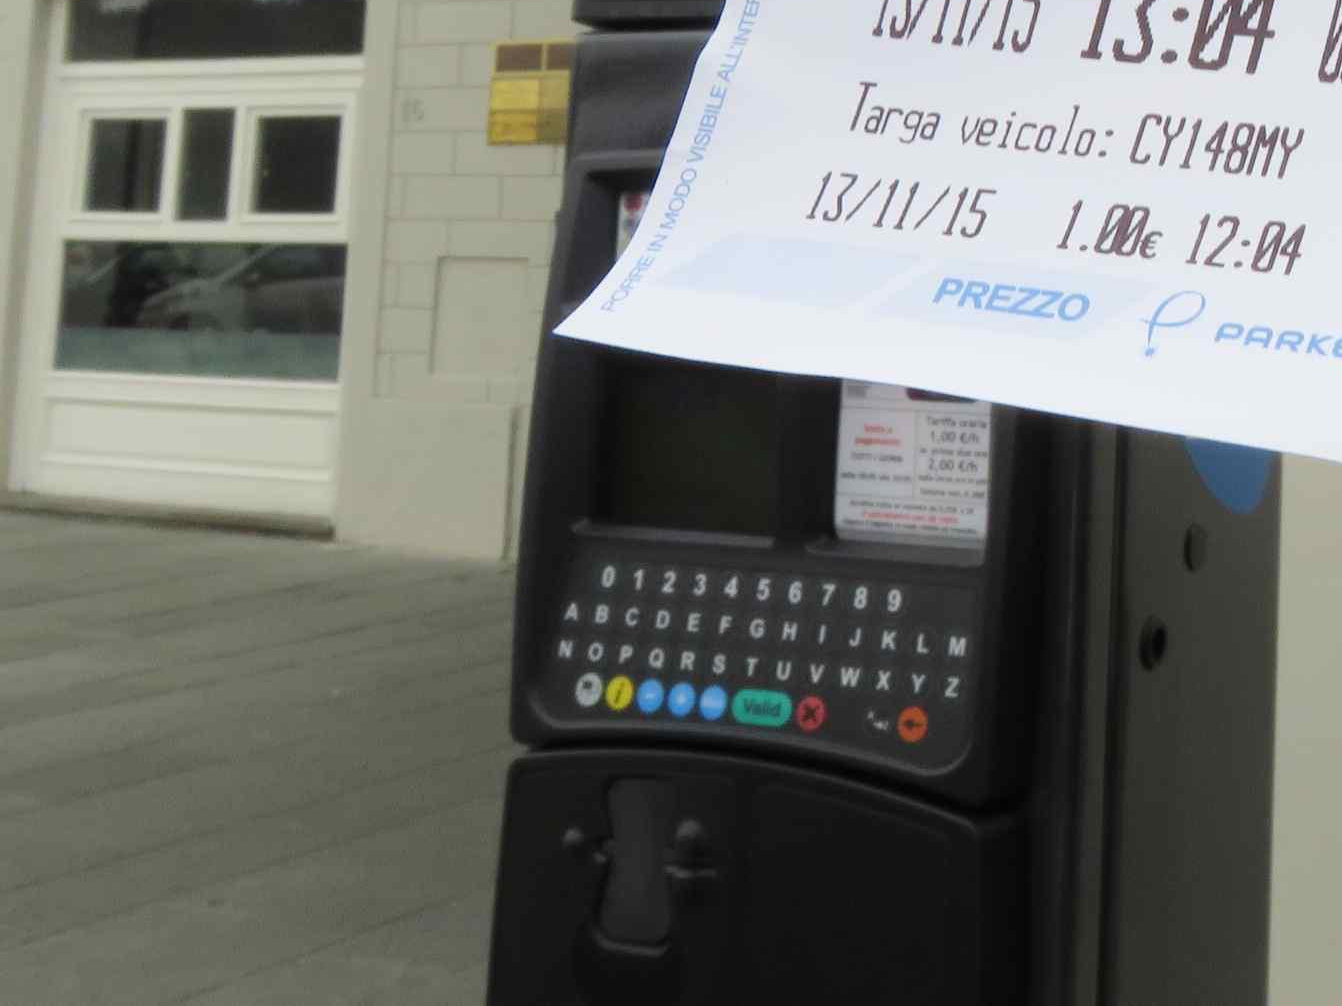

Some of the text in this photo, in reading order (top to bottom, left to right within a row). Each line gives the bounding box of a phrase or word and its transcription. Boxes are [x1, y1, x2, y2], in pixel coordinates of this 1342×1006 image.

[849, 82, 1304, 180] Targa veicolo: CY148MY
[601, 255, 656, 313] PORRE
[647, 233, 668, 254] IN
[660, 168, 698, 233] MODO
[687, 84, 728, 164] VISIBILE
[807, 170, 1306, 278] 13/11/15 1.00€ 12:04
[934, 278, 1091, 323] PREZZO
[601, 565, 903, 613] 0 1 2 3 4 5 6 7 8 9
[564, 602, 967, 657] A B C D E F G H I J K L M
[558, 639, 960, 698] N O P Q R S T U V W X Y Z
